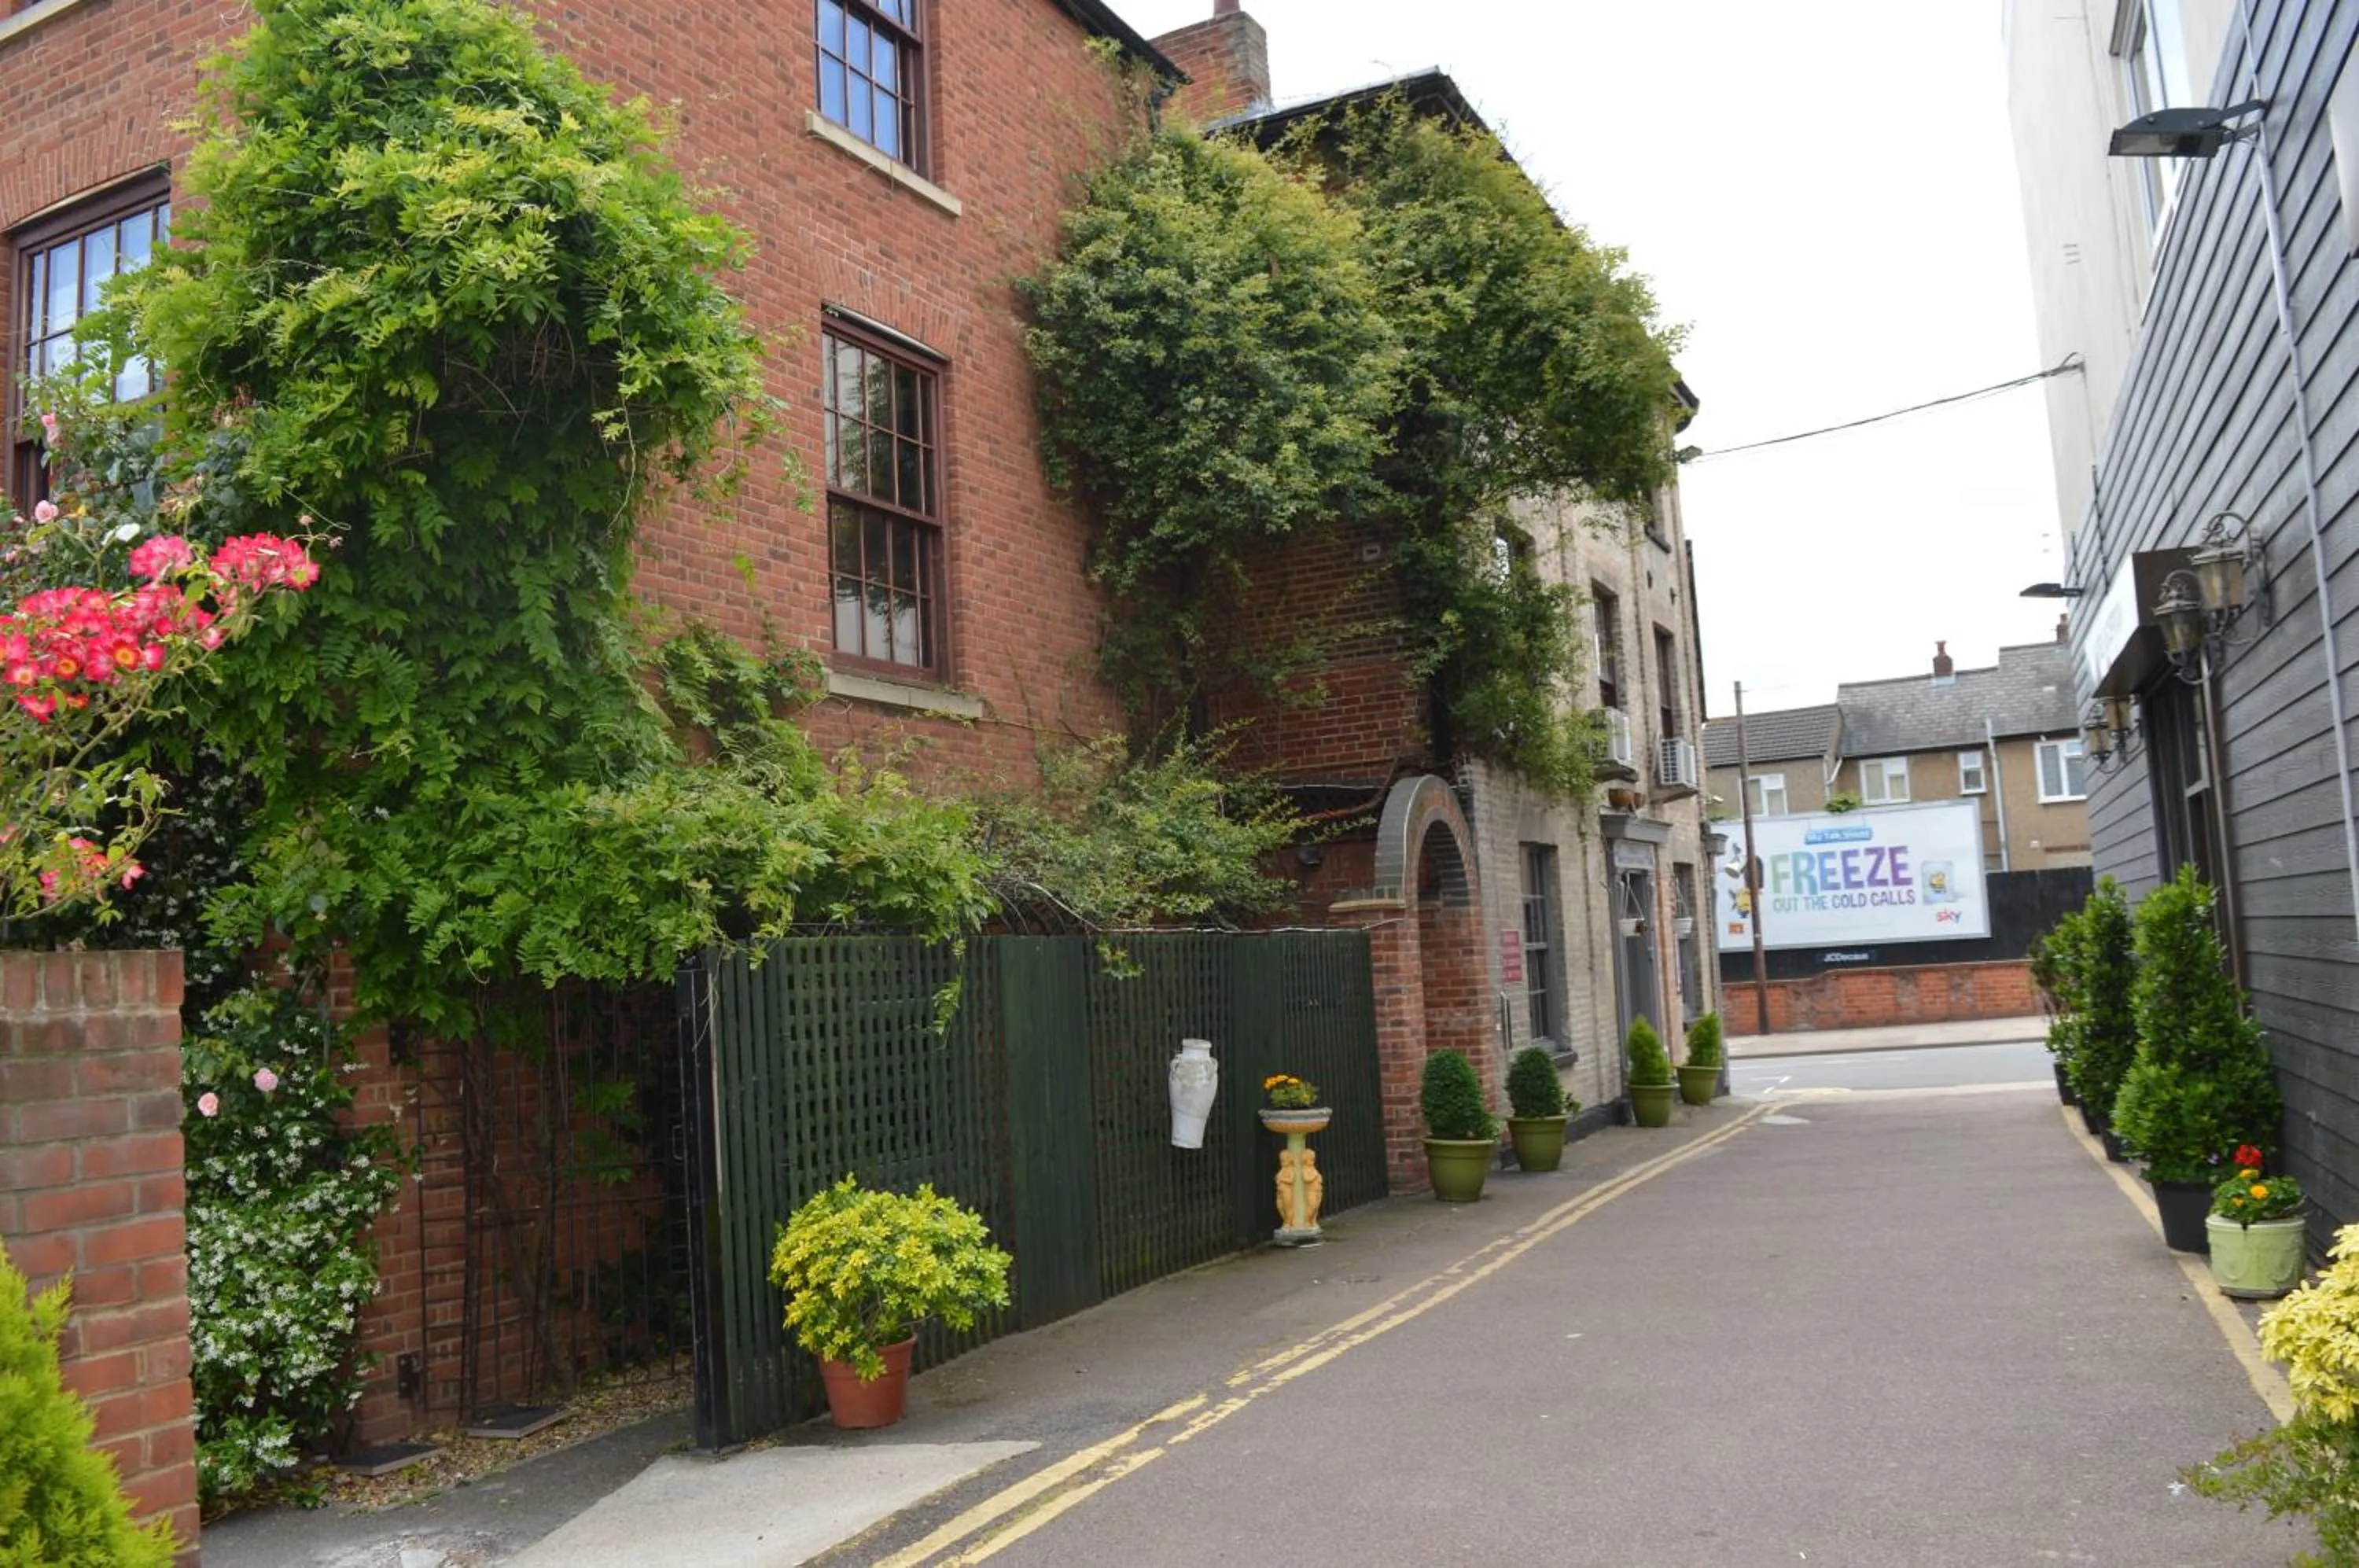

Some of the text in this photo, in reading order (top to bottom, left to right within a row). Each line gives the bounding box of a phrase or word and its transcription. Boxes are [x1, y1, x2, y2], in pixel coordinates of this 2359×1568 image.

[1770, 846, 1913, 894] FREEZE
[1773, 889, 1916, 913] OUT THE COLD CALLS
[1937, 906, 1963, 925] sky
